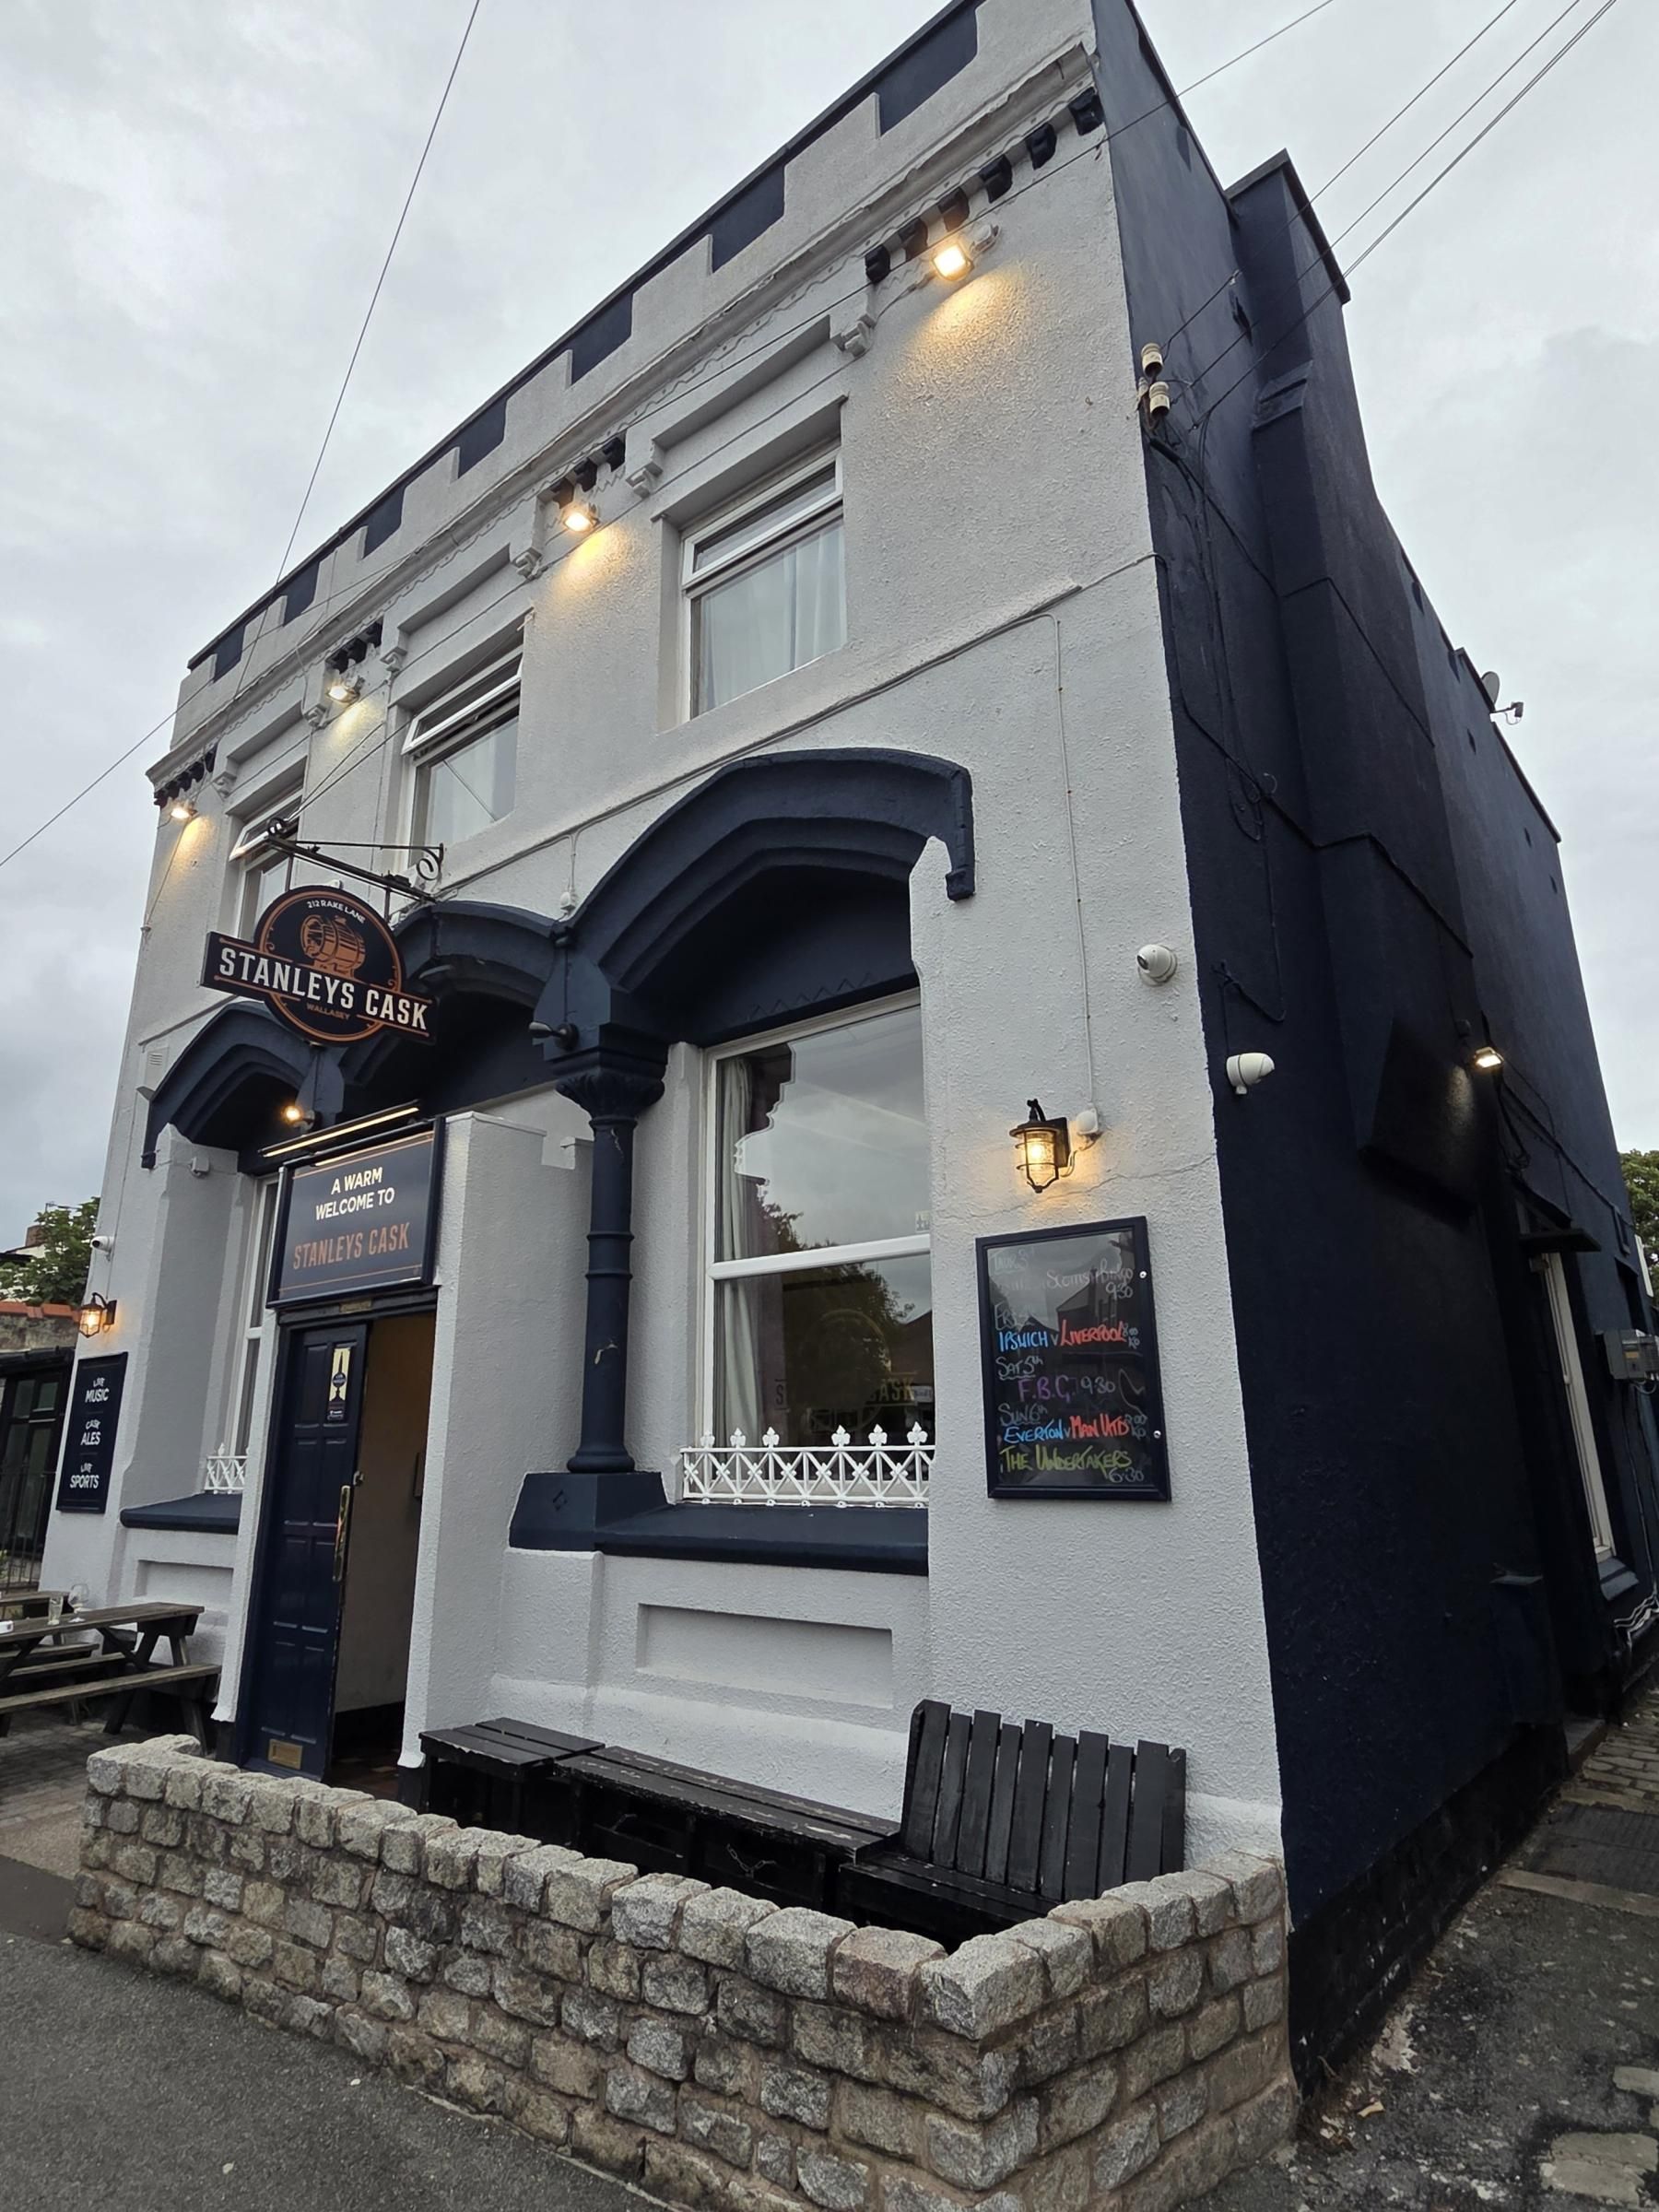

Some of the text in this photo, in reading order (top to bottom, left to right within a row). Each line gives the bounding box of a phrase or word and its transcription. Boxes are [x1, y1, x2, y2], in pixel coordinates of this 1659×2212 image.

[307, 900, 366, 924] 212 RAKE LANE
[218, 947, 429, 1030] STANLEYS CASK
[330, 1166, 383, 1195] A WARM
[315, 1187, 395, 1221] WELCOME TO
[292, 1221, 411, 1270] STANLEYS CASK
[85, 1388, 110, 1403] MUSIC
[80, 1431, 101, 1445] ALES
[1003, 1418, 1064, 1444] EVERTON
[999, 1445, 1033, 1473] THE
[69, 1475, 100, 1489] SPORTS
